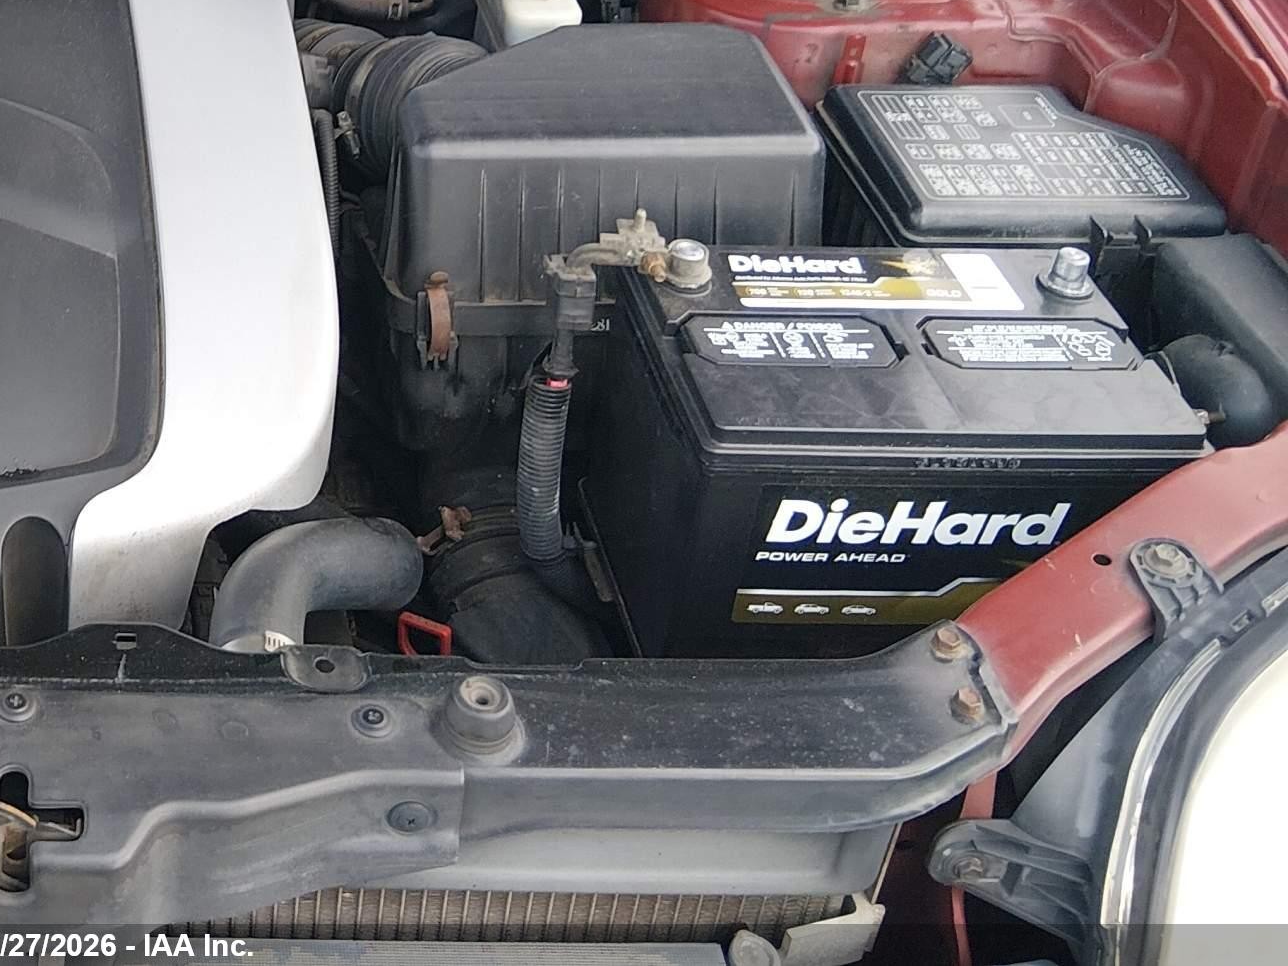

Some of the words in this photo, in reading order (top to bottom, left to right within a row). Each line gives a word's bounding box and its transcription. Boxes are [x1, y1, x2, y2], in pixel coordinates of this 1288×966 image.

[728, 254, 865, 275] DieHard
[765, 498, 1072, 546] DieHard
[754, 552, 828, 564] POWER
[833, 552, 907, 564] AHEAD
